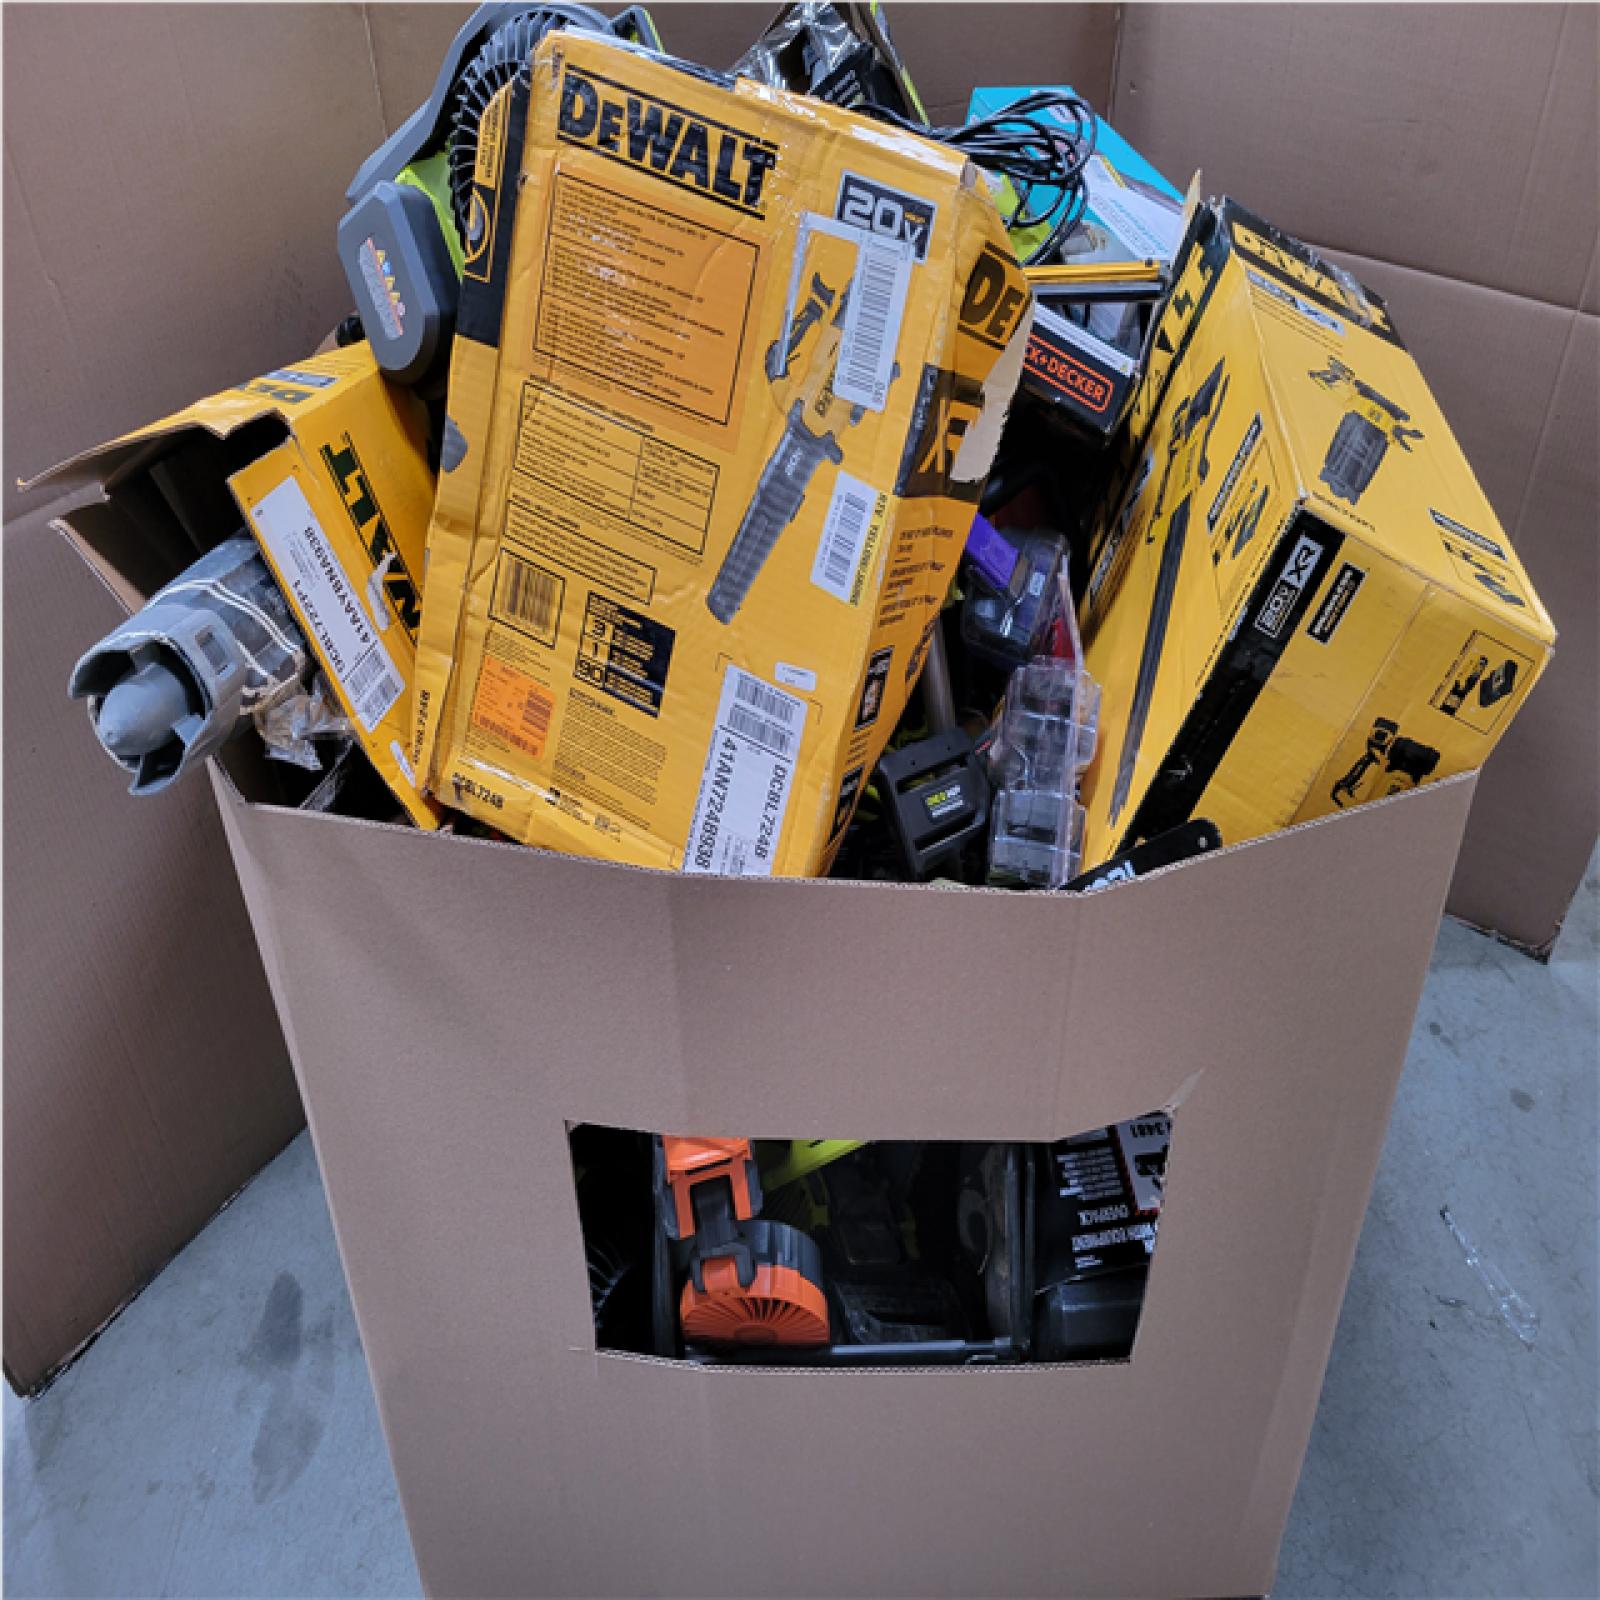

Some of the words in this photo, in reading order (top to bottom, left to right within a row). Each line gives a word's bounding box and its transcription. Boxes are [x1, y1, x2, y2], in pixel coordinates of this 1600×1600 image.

[558, 72, 776, 208] DEWALT
[959, 250, 1029, 341] DE
[694, 736, 738, 870] 41AN724B938
[754, 763, 788, 860] DCBL724B
